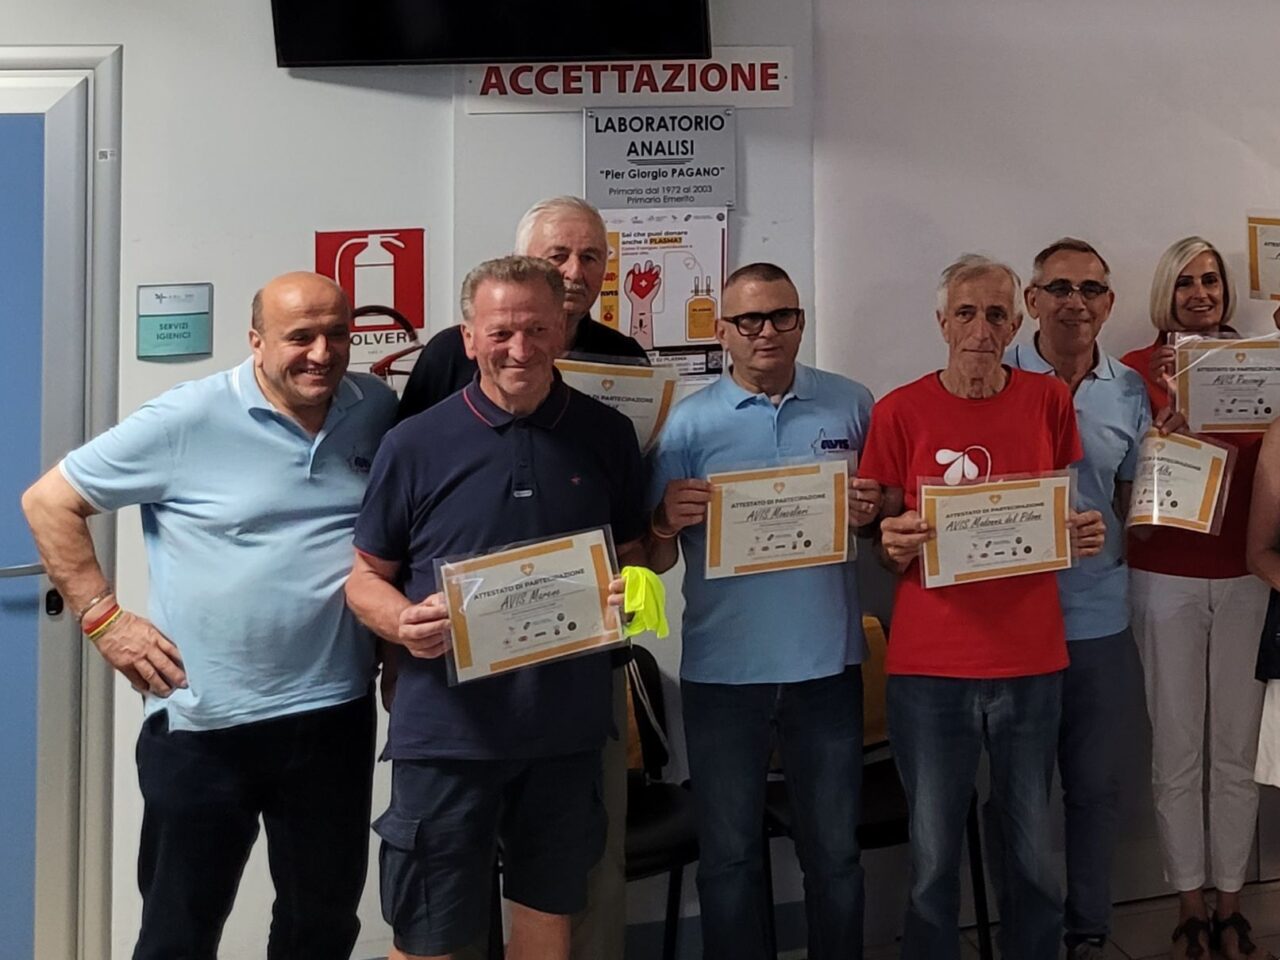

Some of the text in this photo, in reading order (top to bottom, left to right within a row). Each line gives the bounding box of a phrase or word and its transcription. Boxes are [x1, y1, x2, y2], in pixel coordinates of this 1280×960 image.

[479, 62, 780, 96] ACCETTAZIONE
[594, 114, 726, 133] LABORATORIO
[626, 139, 695, 157] ANALISI
[627, 168, 669, 181] Giorgio
[608, 185, 713, 196] Primario dal 1972 al 2003
[626, 195, 696, 205] Primario Emerito
[159, 322, 189, 331] SERVIZI
[156, 331, 192, 341] IGIENICI
[473, 568, 585, 601] ATTESTATO DI PARTECIPAZIONE
[500, 590, 527, 611] AVIS
